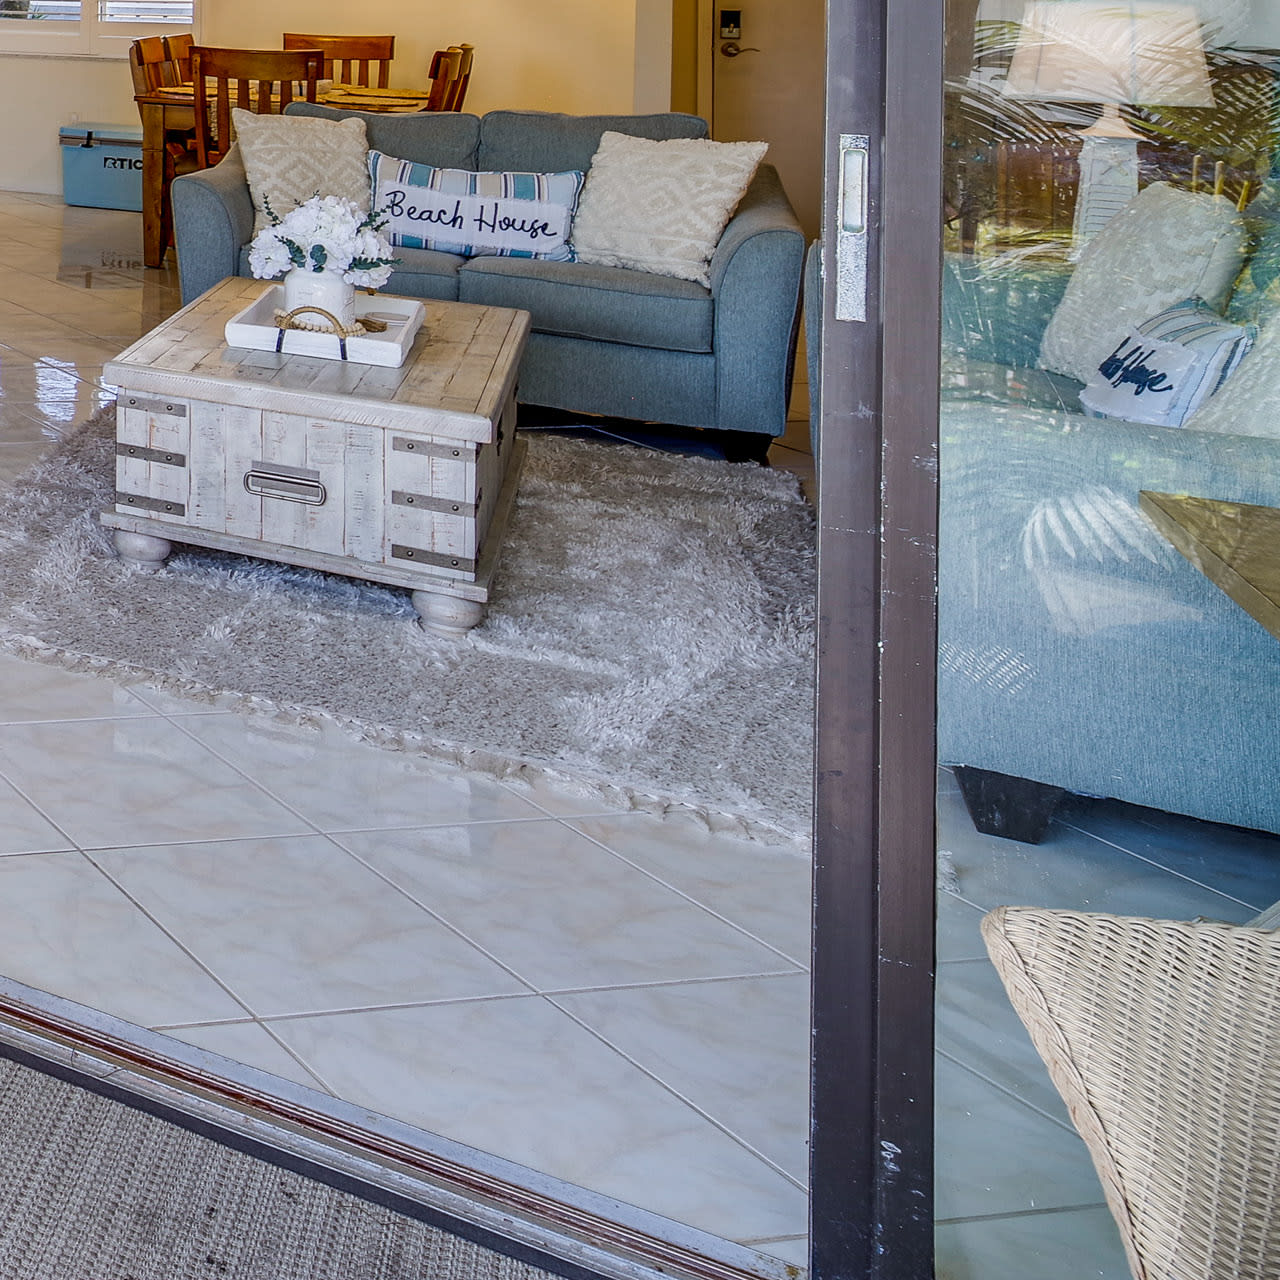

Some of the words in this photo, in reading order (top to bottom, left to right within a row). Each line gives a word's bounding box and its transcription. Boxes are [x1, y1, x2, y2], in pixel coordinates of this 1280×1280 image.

[104, 156, 143, 170] RTIC
[385, 190, 464, 230] Beach
[474, 202, 558, 239] House
